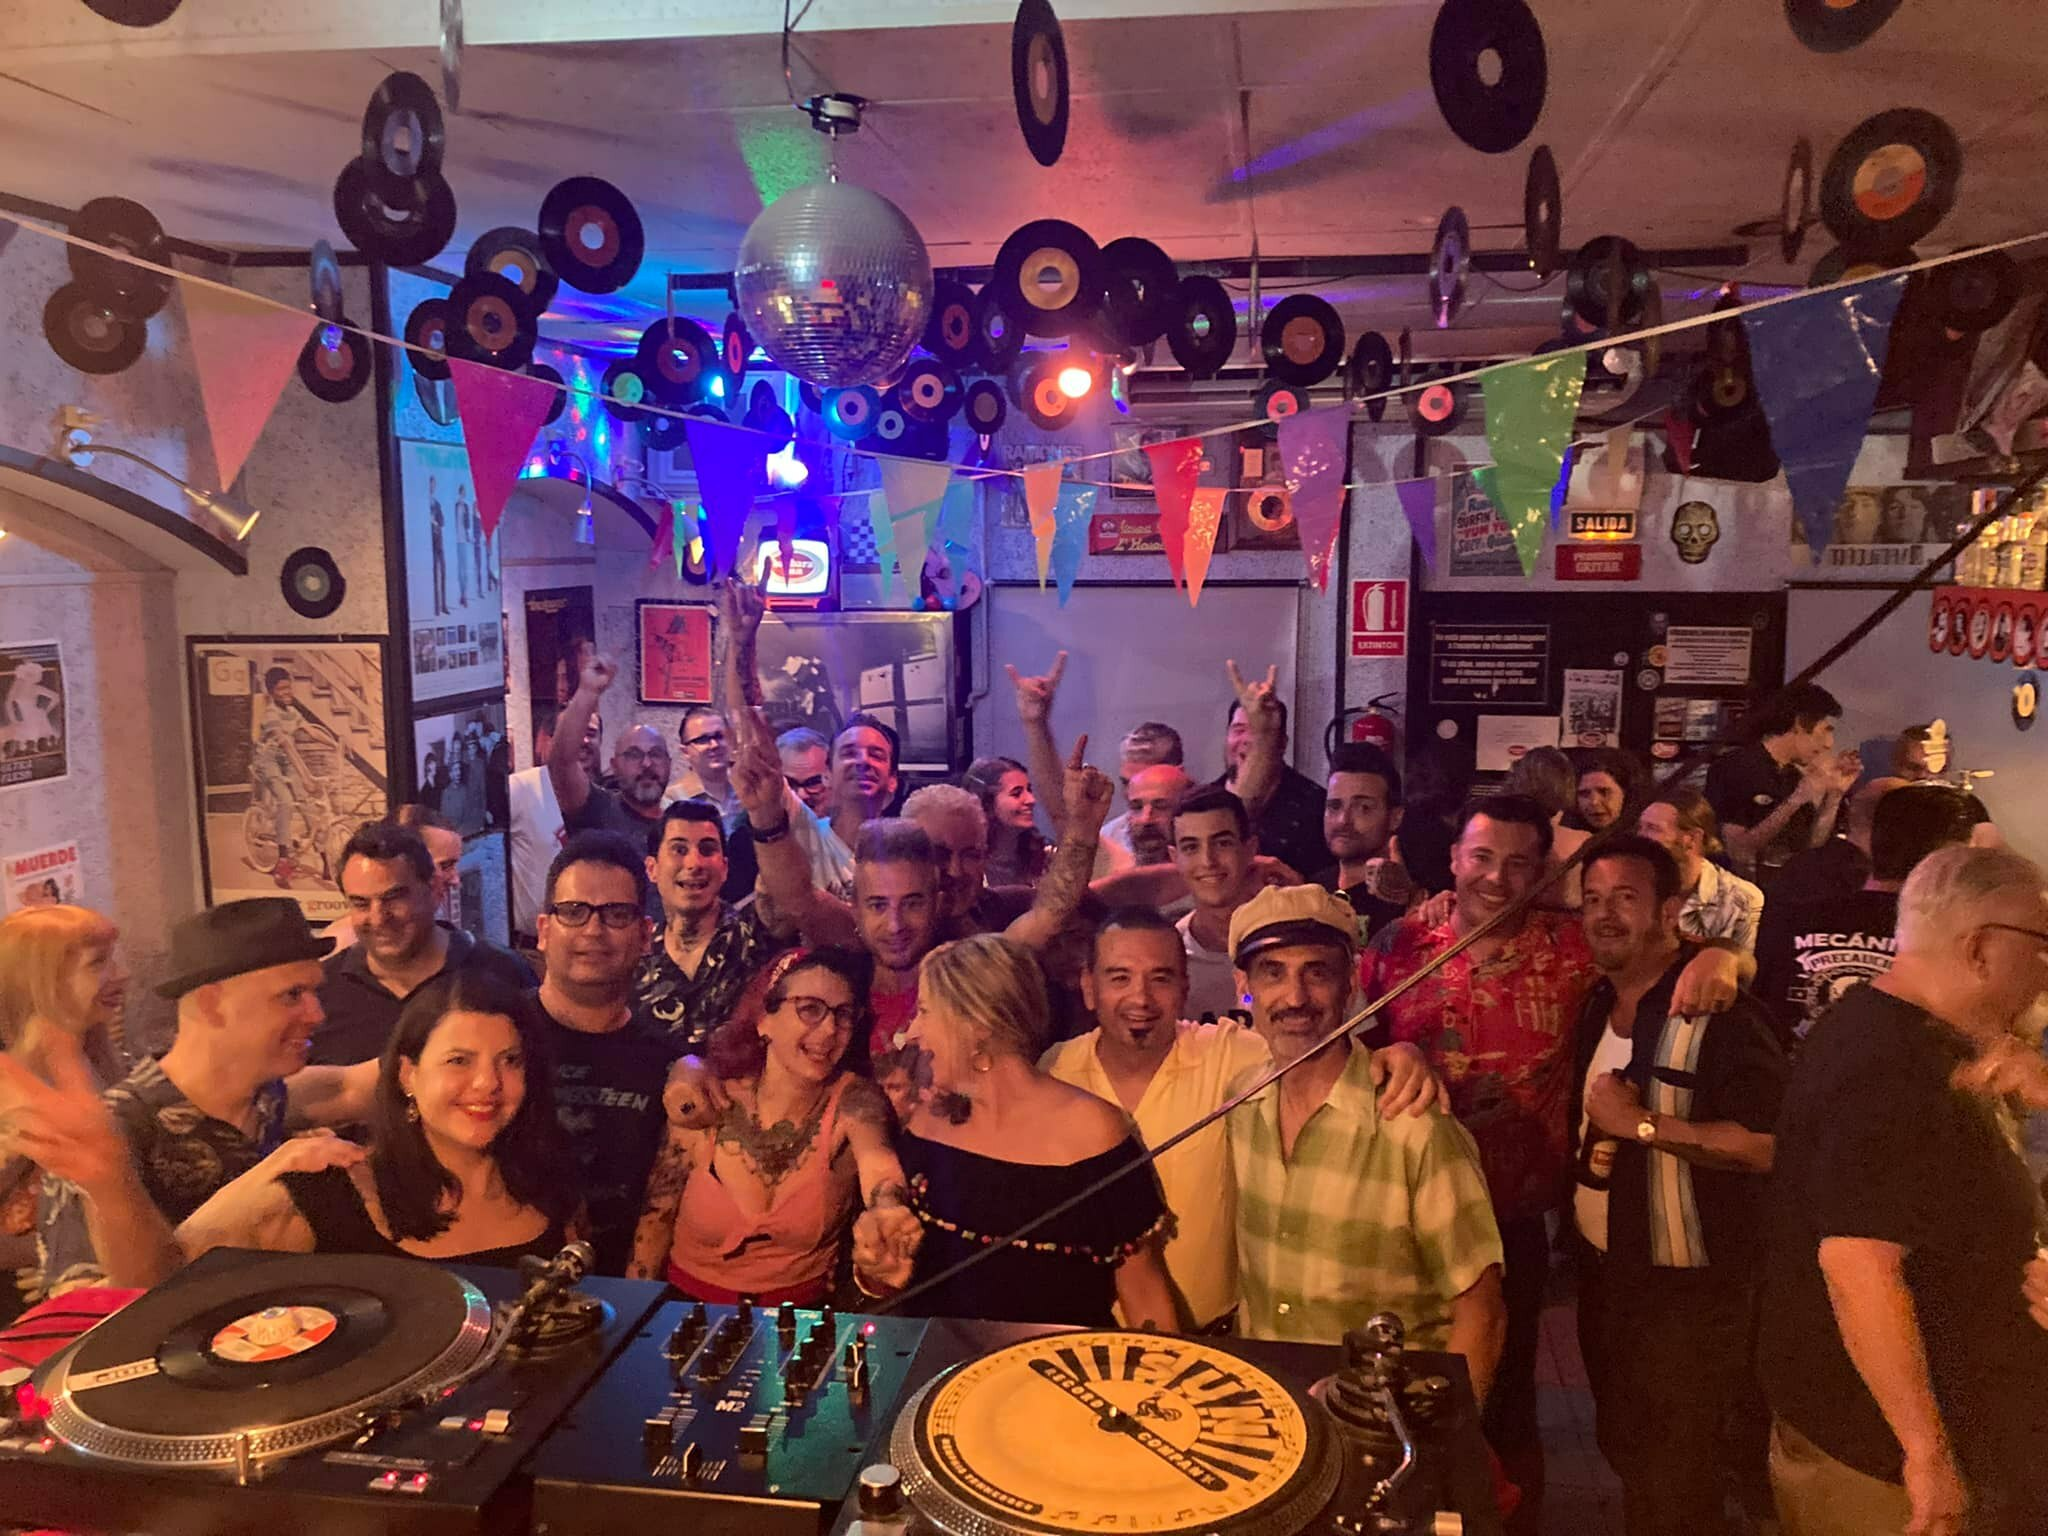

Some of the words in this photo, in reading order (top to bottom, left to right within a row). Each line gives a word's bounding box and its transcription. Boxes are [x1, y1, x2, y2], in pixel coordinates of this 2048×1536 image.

[1575, 515, 1628, 531] SALIDA
[1357, 641, 1399, 650] EXTINTOR
[1132, 1350, 1280, 1440] SUN
[715, 1399, 746, 1412] M2
[1043, 1366, 1105, 1410] RECORD
[1136, 1431, 1217, 1486] COMPANY
